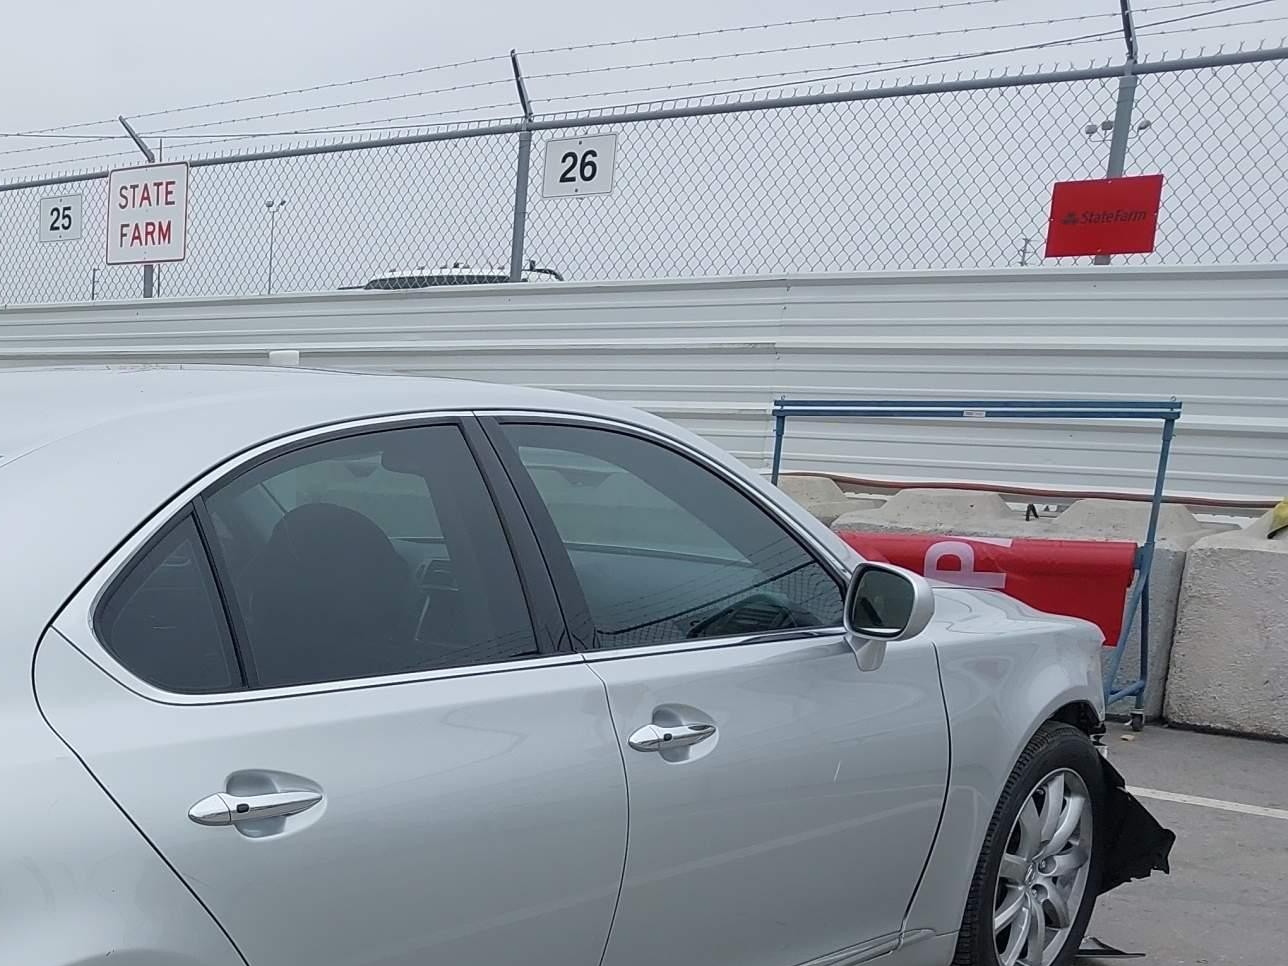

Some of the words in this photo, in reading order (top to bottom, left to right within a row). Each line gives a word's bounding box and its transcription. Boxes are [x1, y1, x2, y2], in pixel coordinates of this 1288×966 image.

[559, 149, 598, 183] 26
[118, 180, 176, 210] STATE
[49, 206, 72, 232] 25
[120, 220, 172, 248] FARM
